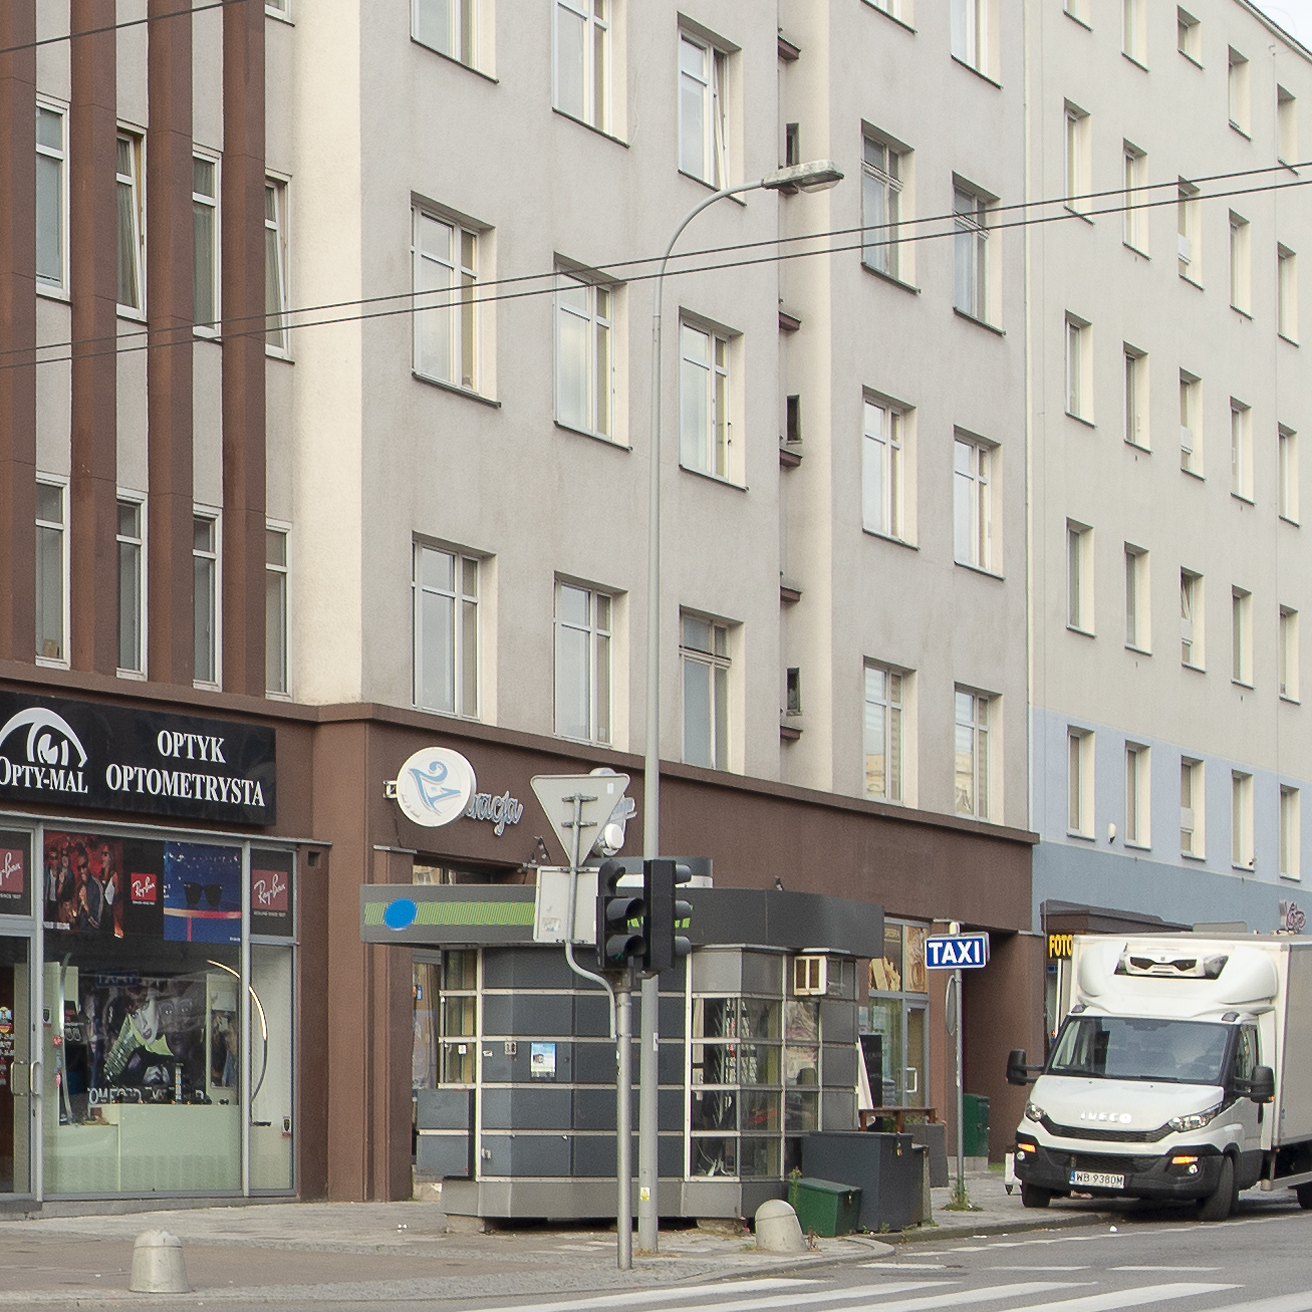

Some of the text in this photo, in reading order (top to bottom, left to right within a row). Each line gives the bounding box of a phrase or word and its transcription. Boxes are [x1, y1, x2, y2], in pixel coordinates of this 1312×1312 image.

[157, 730, 226, 764] OPTYK
[105, 763, 266, 807] OPTOMETRYSTA
[253, 873, 286, 905] Ray-Ban
[927, 940, 981, 965] TAXI
[1080, 1111, 1132, 1124] IVECO
[1076, 1173, 1090, 1182] WB
